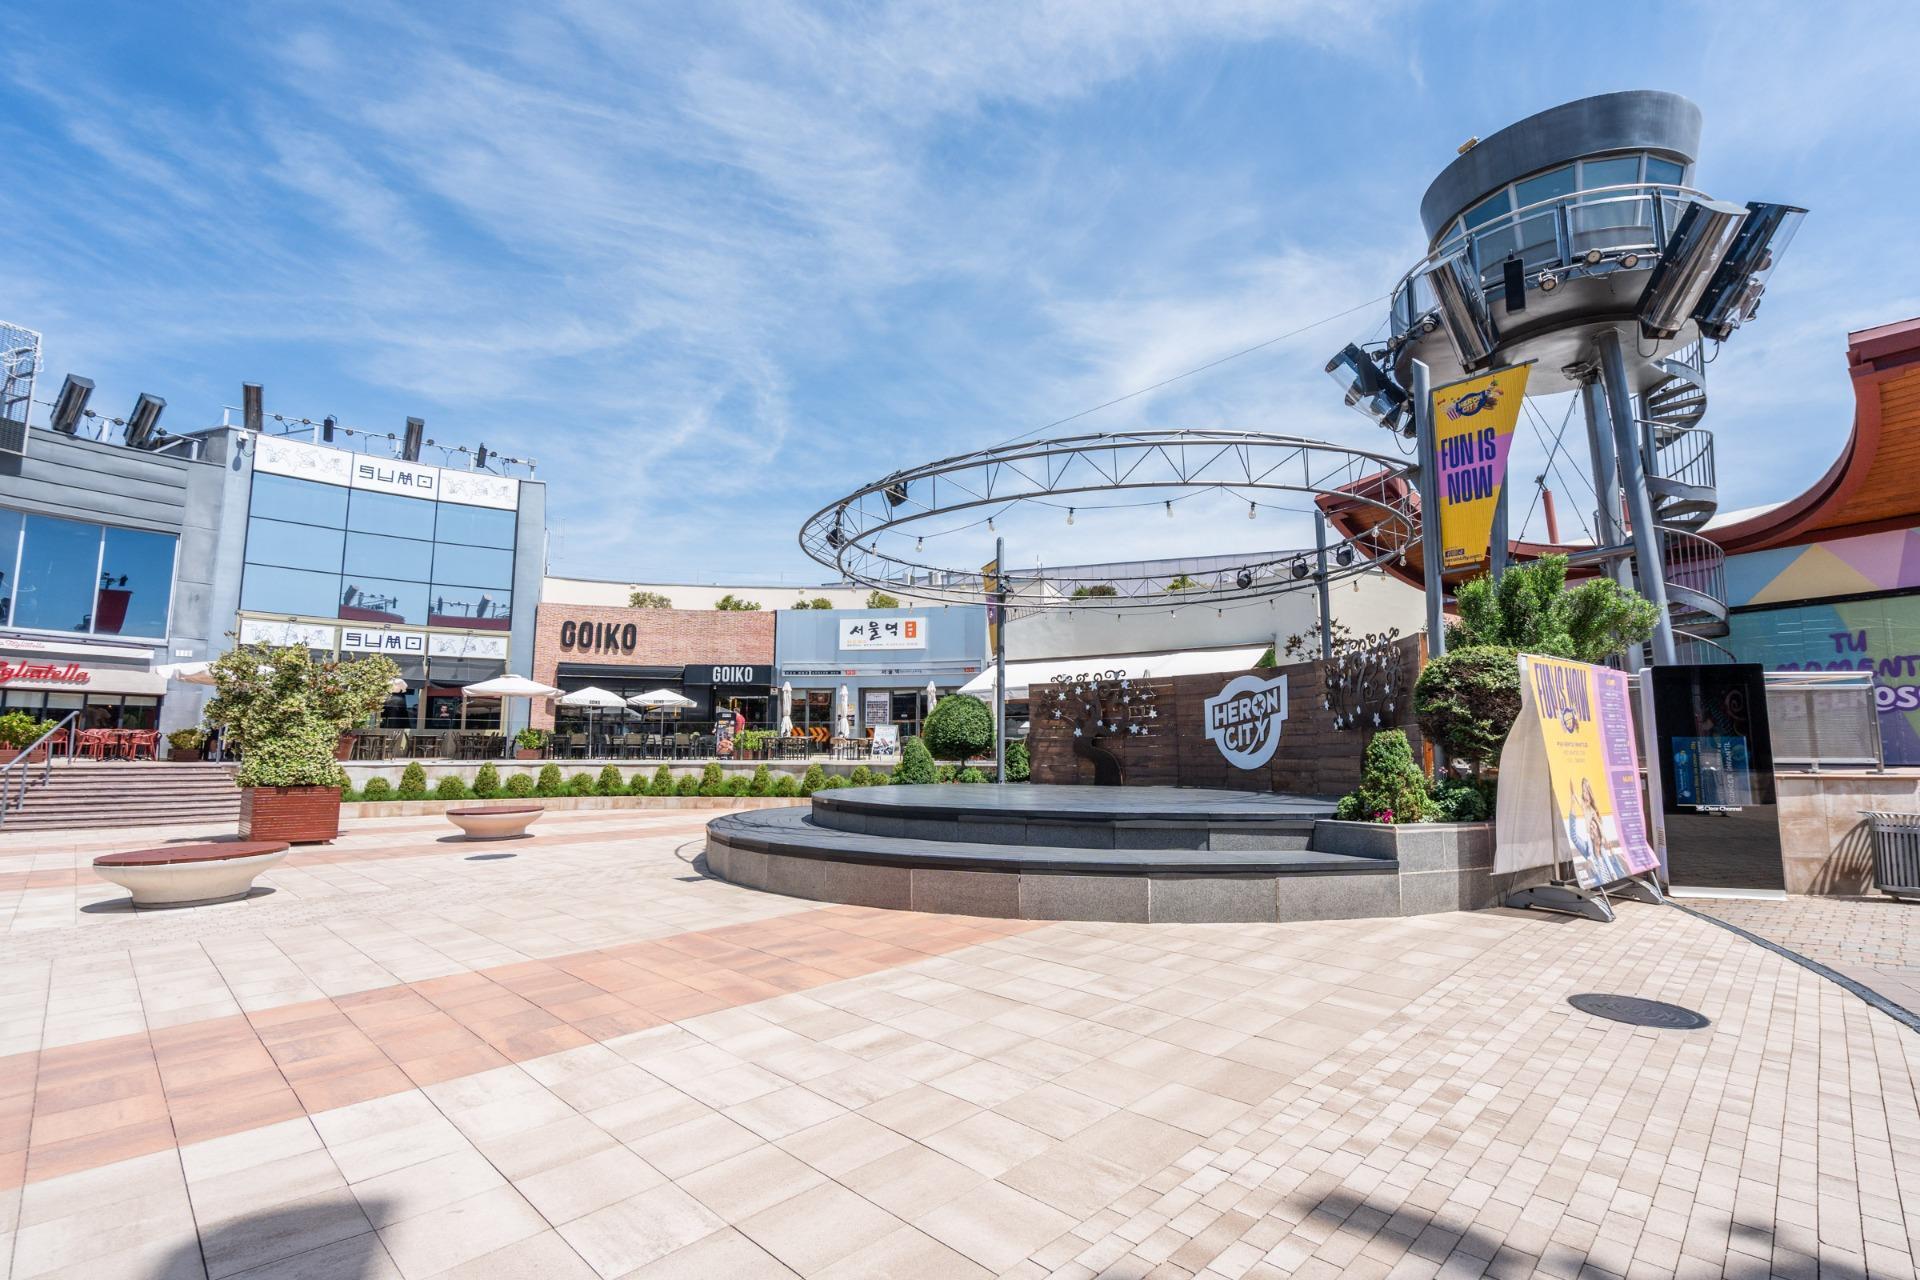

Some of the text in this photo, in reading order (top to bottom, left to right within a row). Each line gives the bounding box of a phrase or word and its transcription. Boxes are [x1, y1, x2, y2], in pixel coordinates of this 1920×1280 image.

[1441, 427, 1497, 471] FUN IS
[359, 465, 433, 488] SUMO
[1447, 464, 1493, 505] NOW
[346, 632, 422, 650] SUMO
[561, 620, 637, 650] GOIKO
[849, 621, 898, 641] 서울역
[1829, 630, 1868, 654] TU
[0, 660, 88, 684] gliatella
[712, 666, 753, 683] GOIKO
[1776, 655, 1920, 678] OMENT
[1534, 663, 1558, 719] FUN
[1565, 667, 1591, 722] NOW
[1214, 688, 1278, 727] HERON
[1225, 718, 1270, 751] CITY
